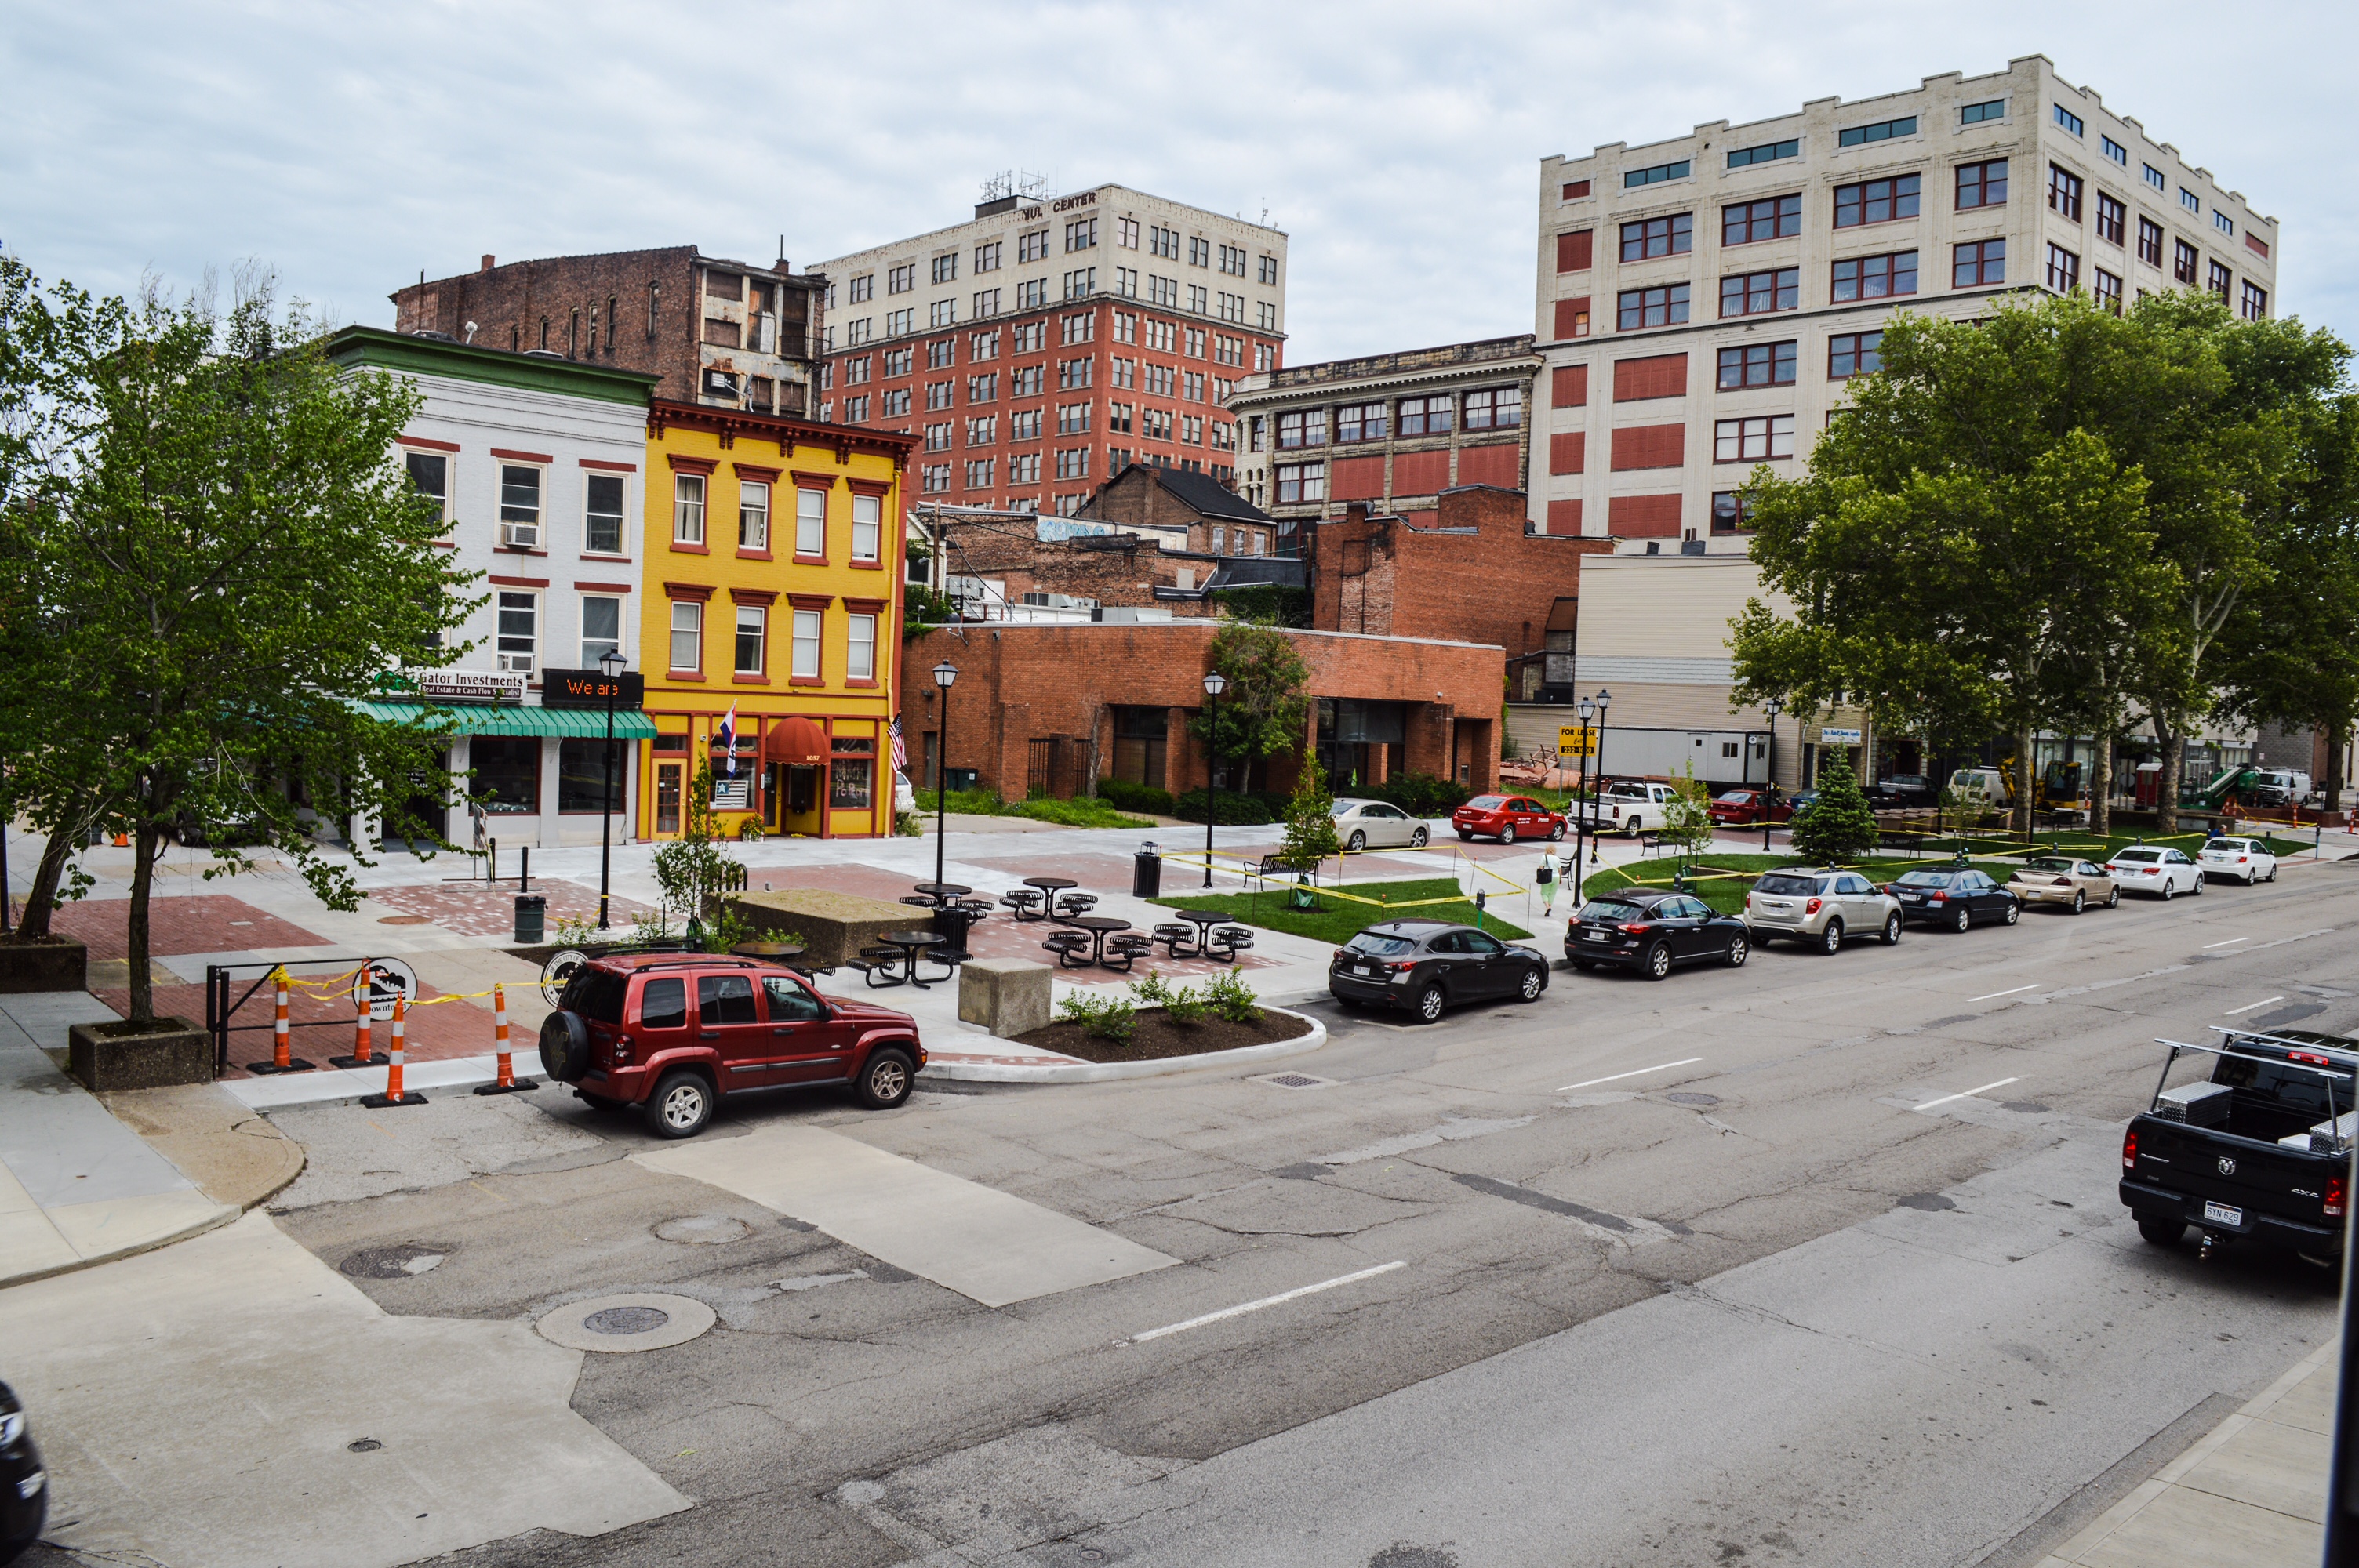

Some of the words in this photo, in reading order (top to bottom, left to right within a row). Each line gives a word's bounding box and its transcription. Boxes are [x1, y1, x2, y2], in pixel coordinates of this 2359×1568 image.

[1053, 192, 1096, 212] CENTER
[420, 672, 452, 684] Gator
[456, 673, 523, 687] Investments
[567, 679, 593, 695] We
[597, 684, 619, 695] are
[436, 686, 456, 695] Estate
[493, 688, 520, 697] Scialist
[369, 1004, 406, 1013] ownton
[2207, 1207, 2223, 1218] 6YN
[2223, 1211, 2239, 1222] 629
